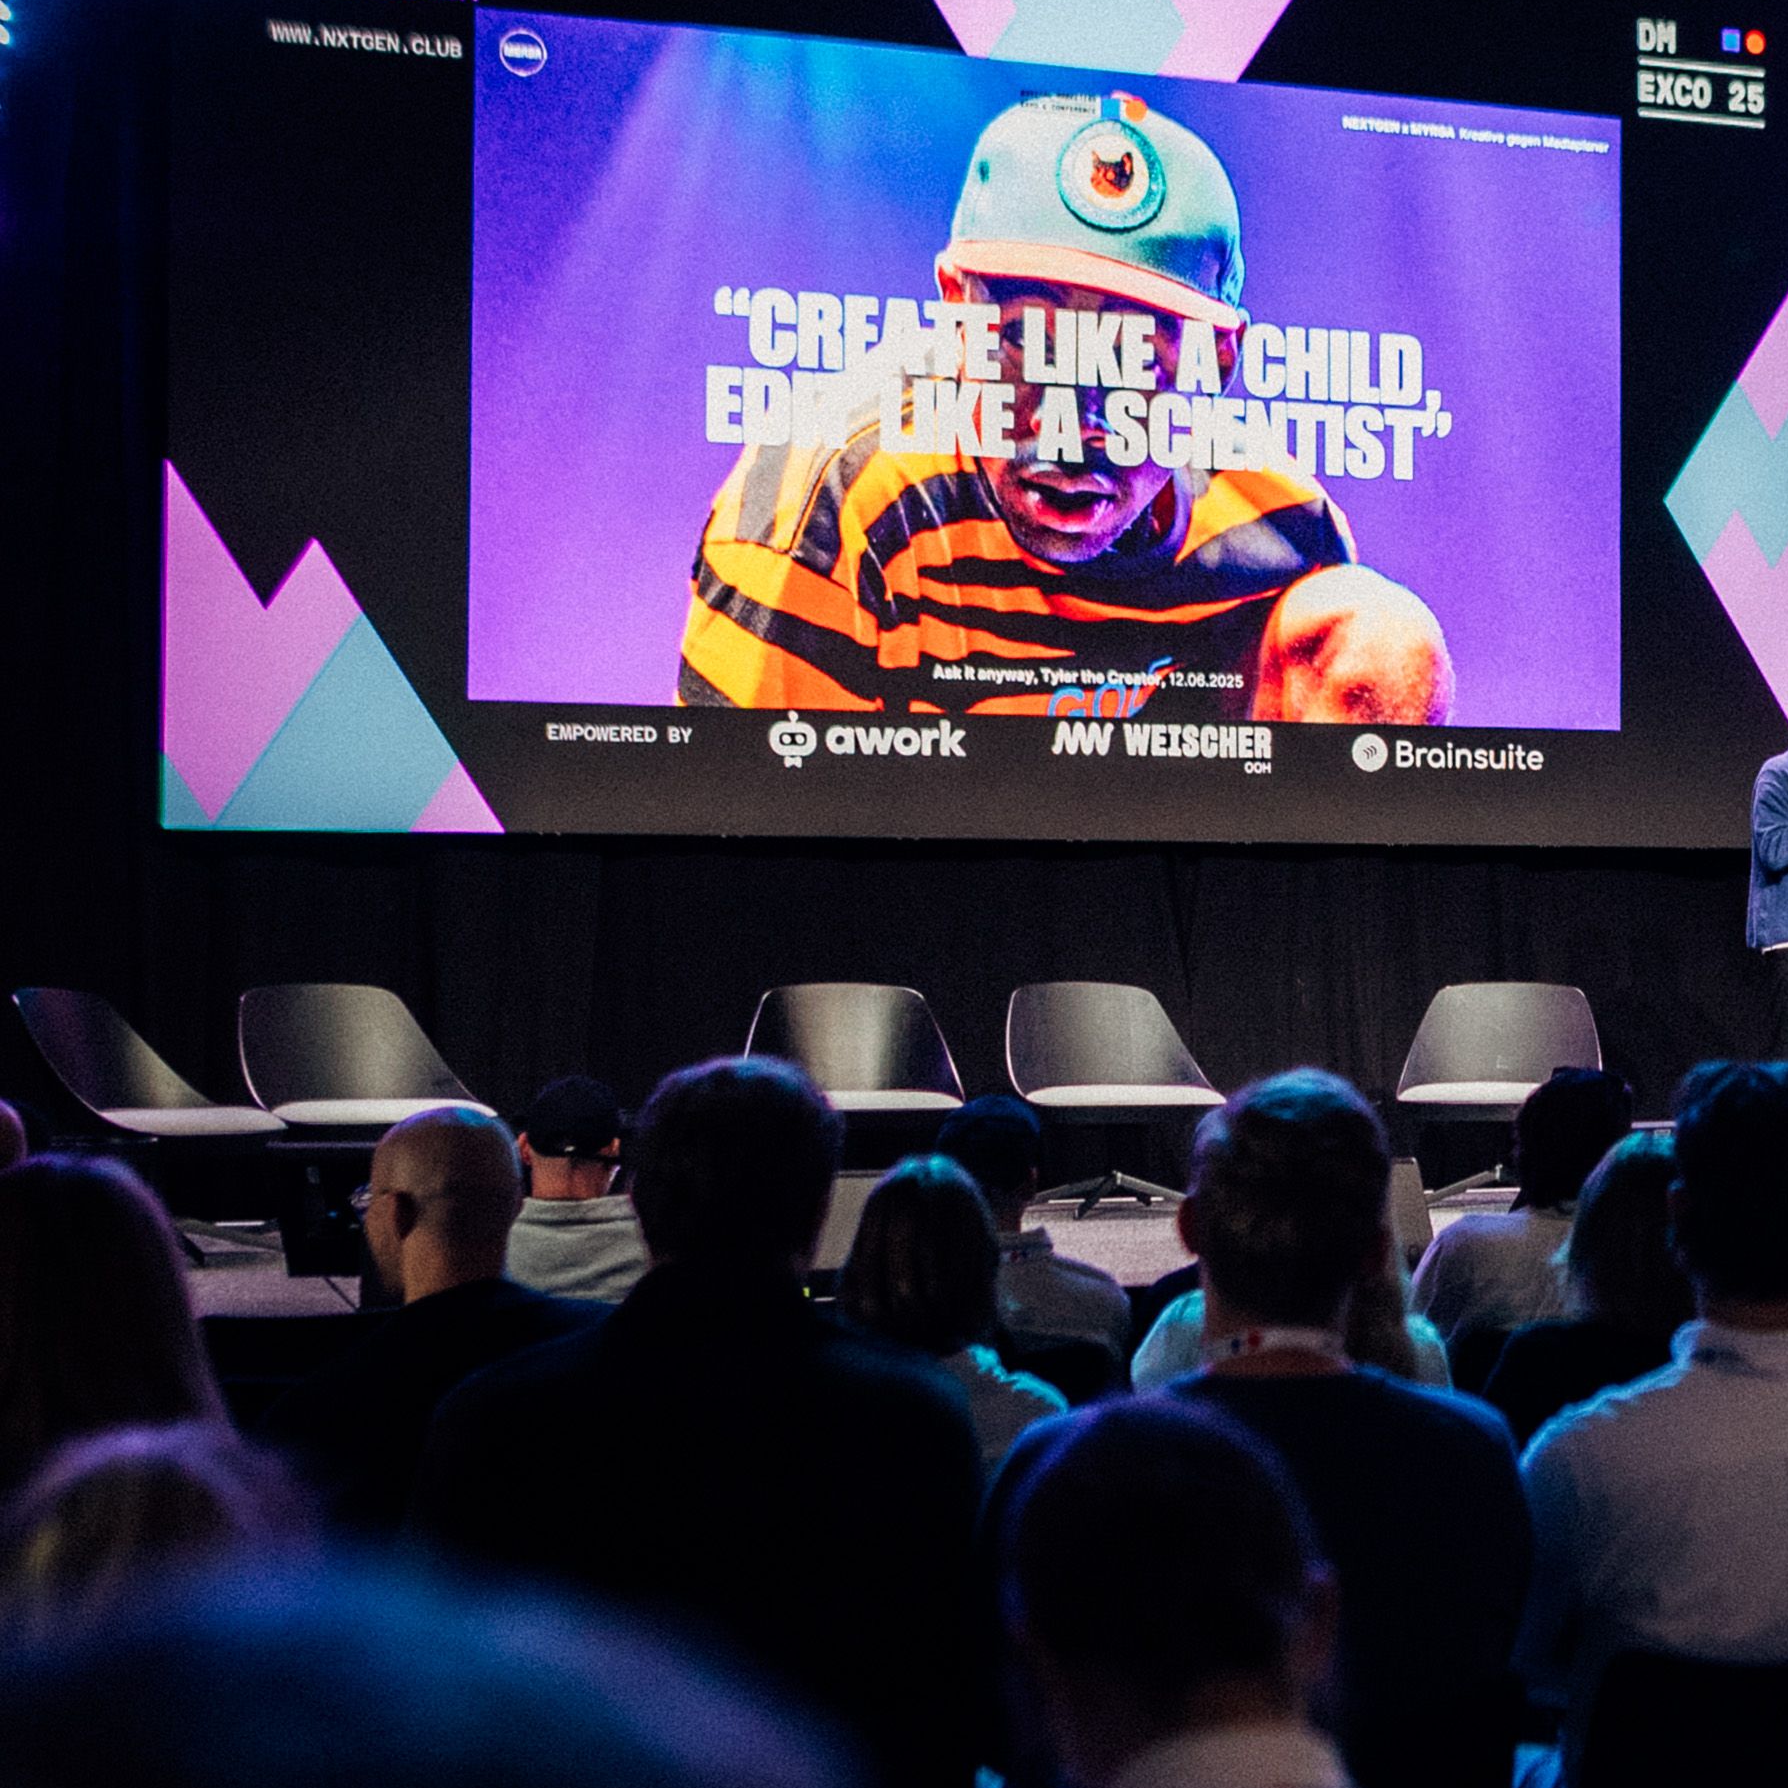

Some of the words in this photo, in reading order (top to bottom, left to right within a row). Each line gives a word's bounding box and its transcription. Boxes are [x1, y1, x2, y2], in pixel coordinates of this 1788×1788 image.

[268, 19, 463, 59] WWW.NXTGEN.CLUB
[1637, 17, 1676, 54] DM
[1637, 71, 1712, 109] EXCO
[1728, 80, 1765, 115] 25
[1022, 306, 1157, 391] LIKE
[1176, 318, 1222, 394] A
[1242, 322, 1442, 419] CHILD,
[879, 375, 1016, 460] LIKE
[1036, 385, 1085, 464] A
[932, 663, 962, 680] Ask
[964, 664, 976, 681] it
[977, 666, 1038, 685] anyway,
[1040, 667, 1079, 686] Tyler
[1081, 668, 1105, 684] the
[1106, 669, 1166, 689] Creator,
[546, 722, 658, 743] EMPOWERED
[667, 725, 693, 744] BY
[825, 719, 967, 758] awork
[1123, 723, 1272, 759] WEISCHER
[1244, 761, 1272, 774] OOH
[1395, 742, 1545, 771] Brainsuite
